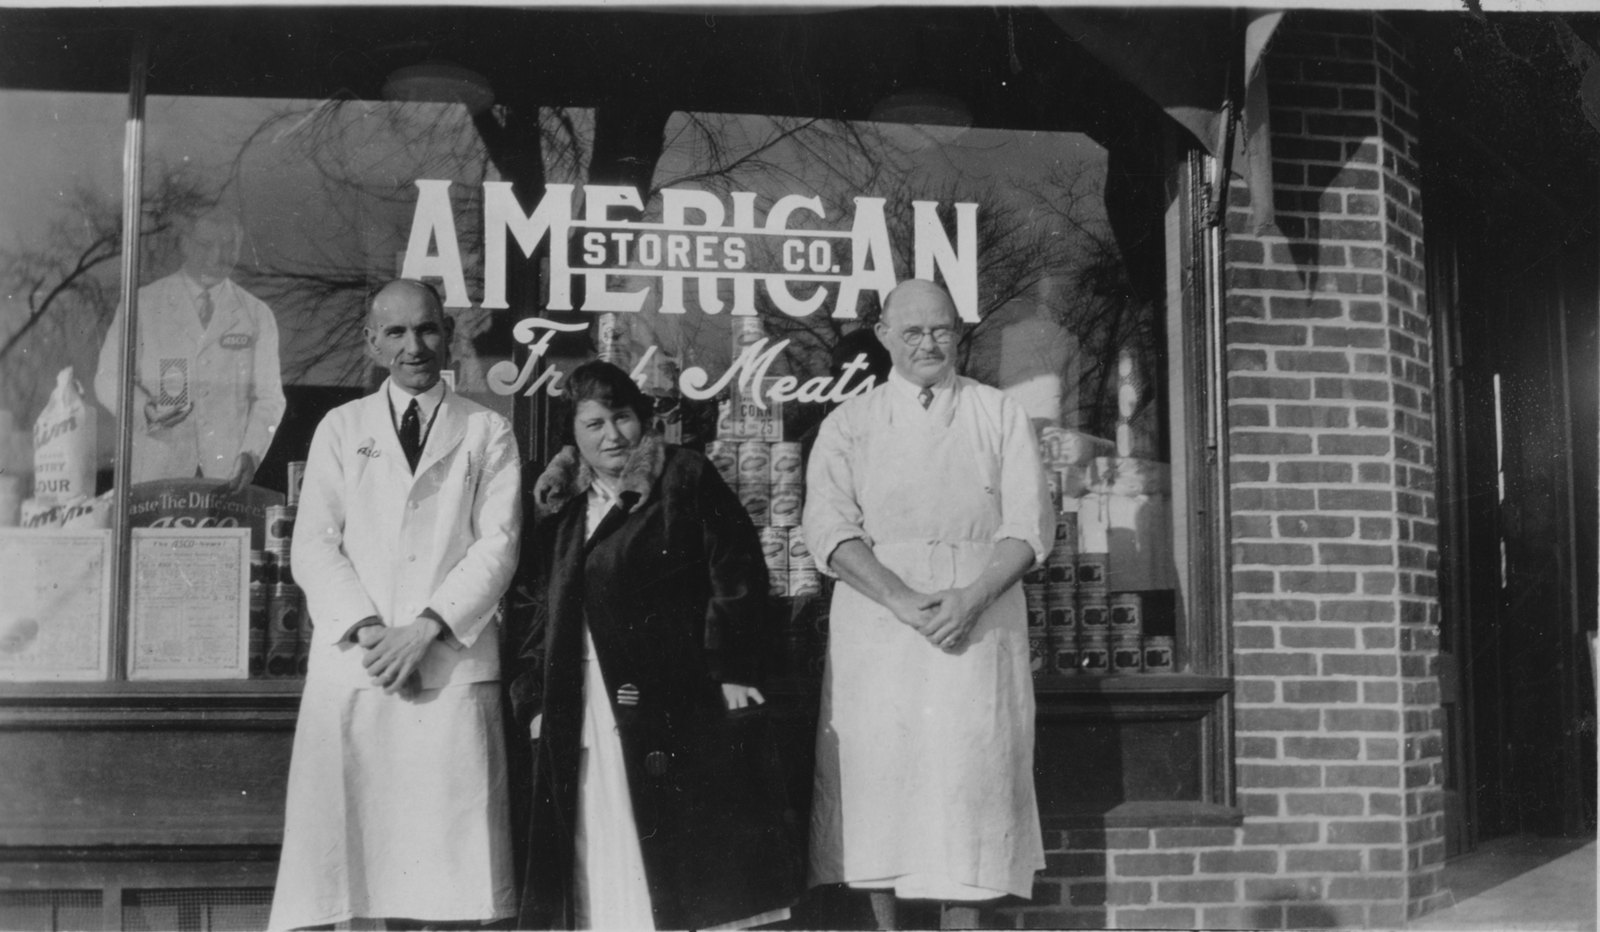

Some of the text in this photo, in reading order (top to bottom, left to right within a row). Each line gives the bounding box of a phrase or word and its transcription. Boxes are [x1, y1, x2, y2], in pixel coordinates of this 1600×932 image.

[401, 179, 981, 323] AMERICAN
[583, 231, 841, 273] STORES CO.
[487, 317, 877, 410] Frh Meats
[129, 498, 159, 515] aste
[159, 494, 187, 509] The
